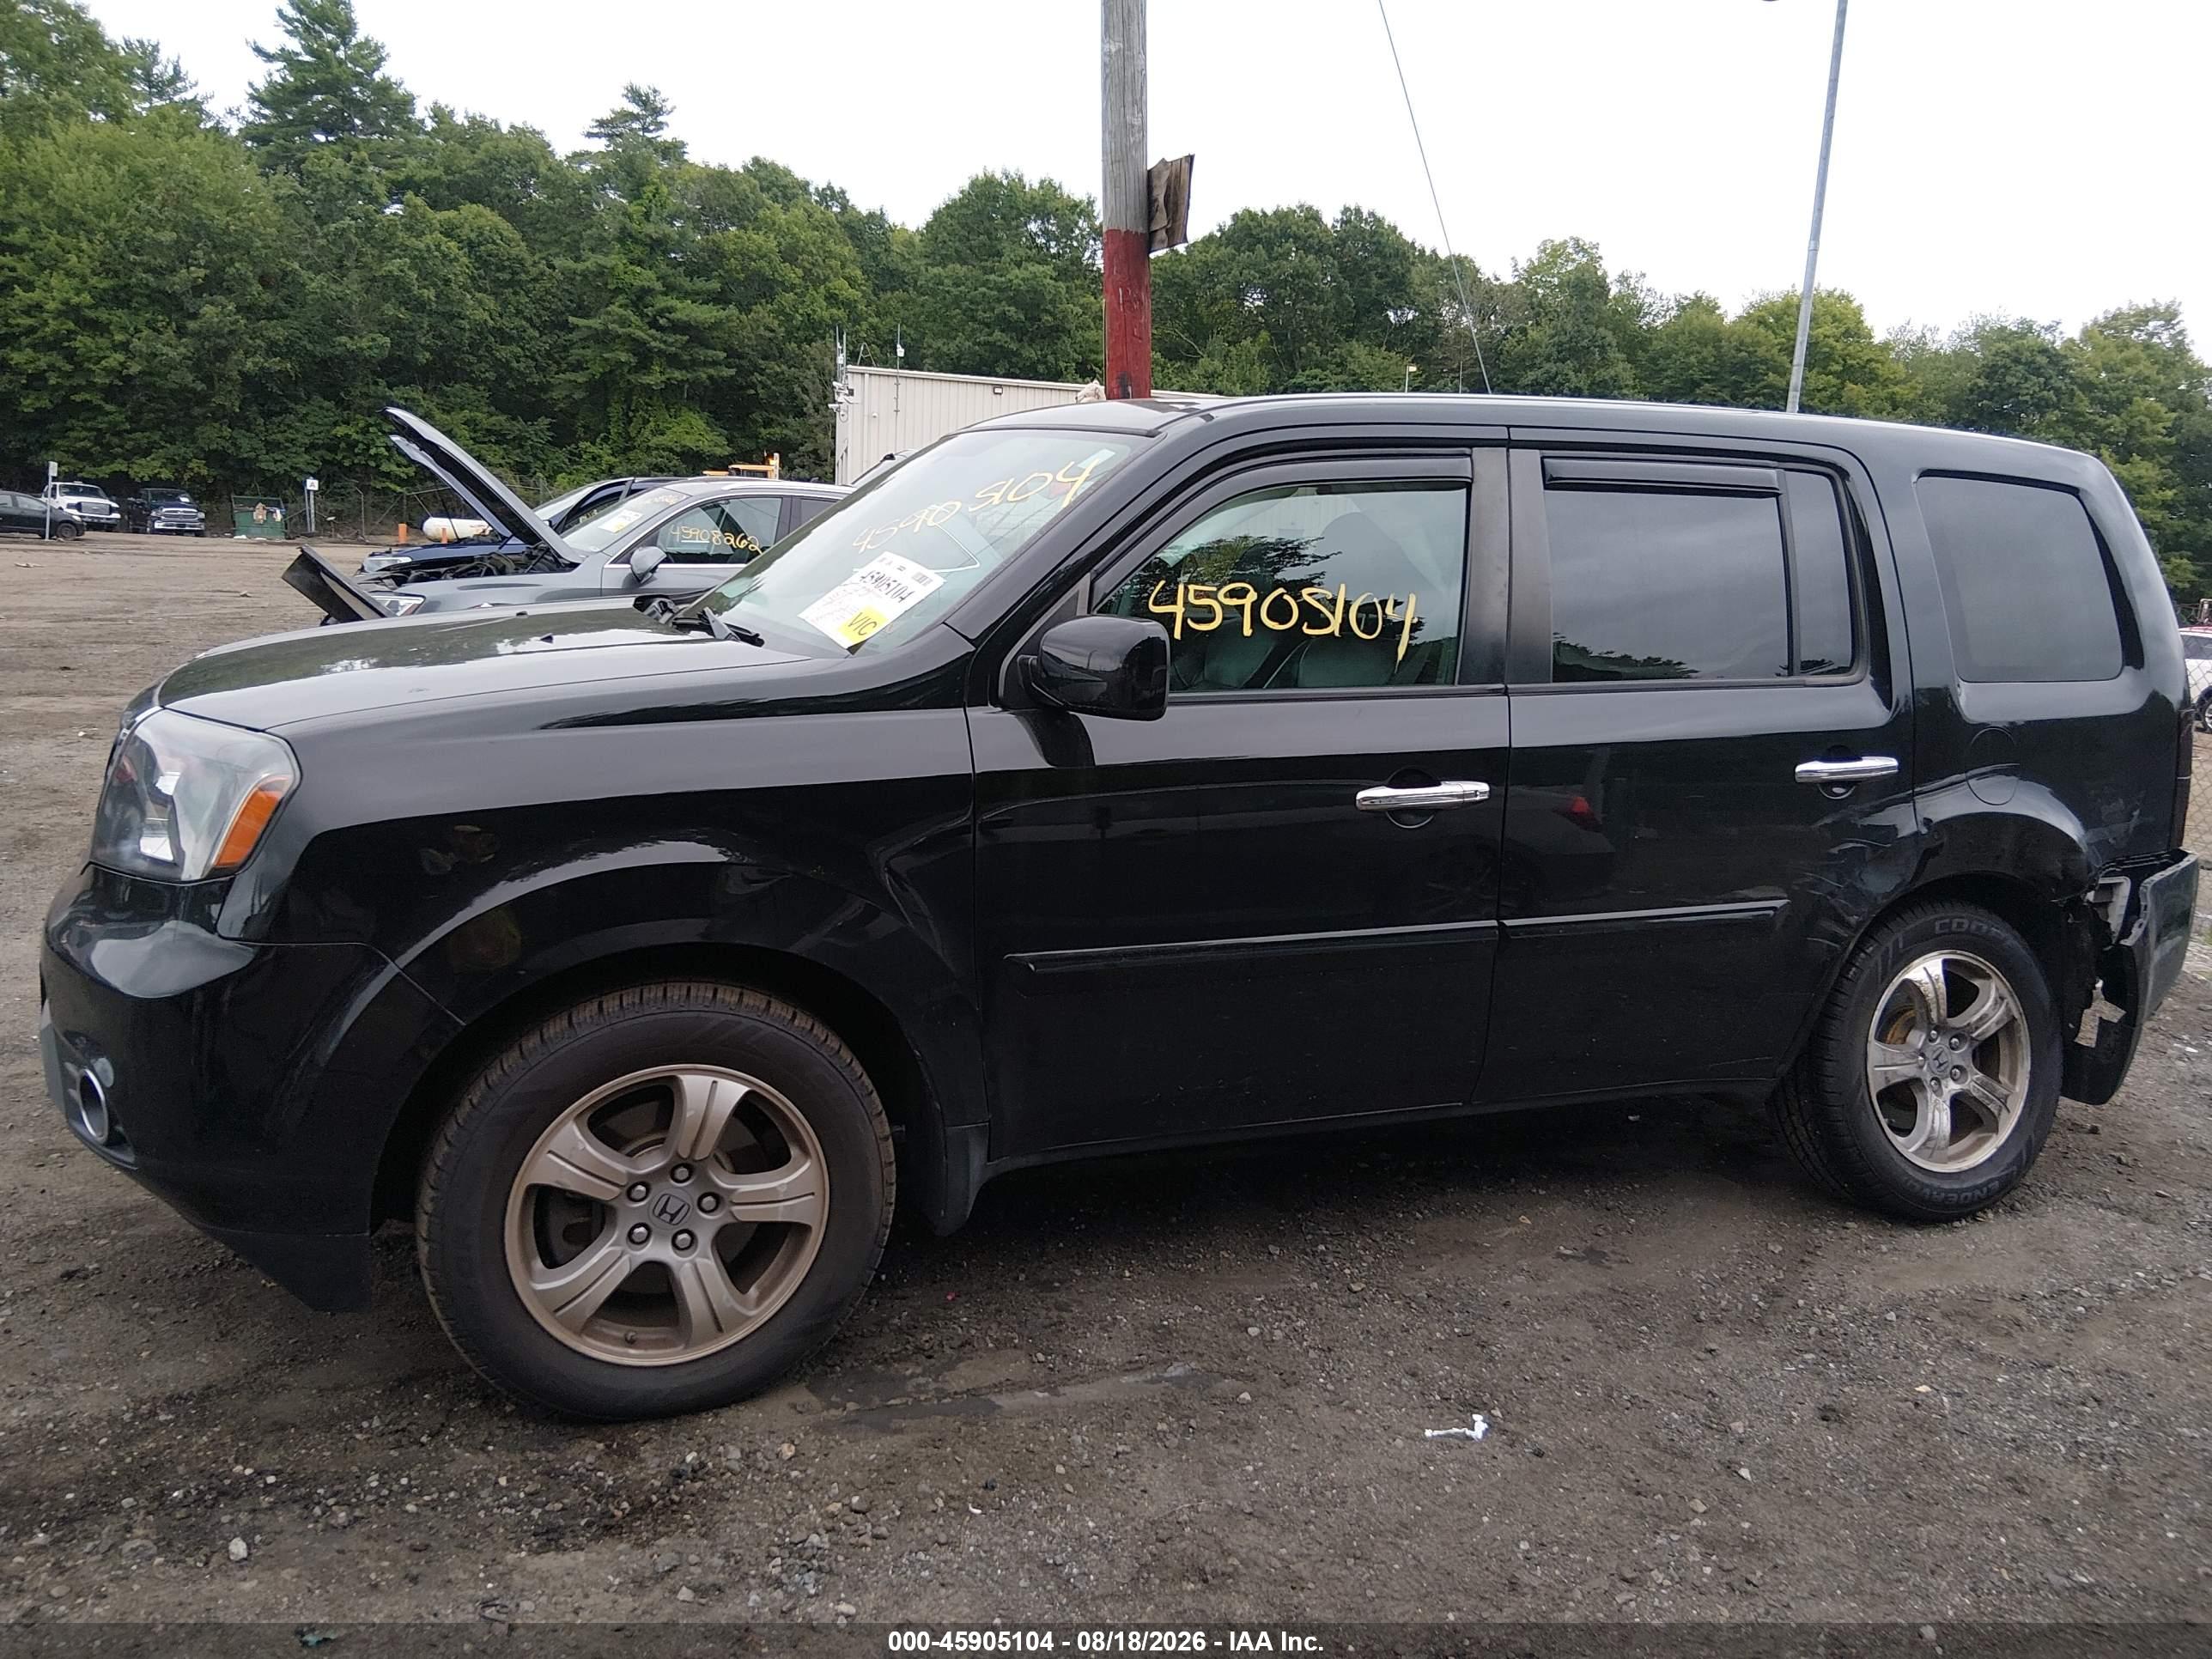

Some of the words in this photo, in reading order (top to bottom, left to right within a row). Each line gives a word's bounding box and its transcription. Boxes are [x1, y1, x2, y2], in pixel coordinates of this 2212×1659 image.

[669, 524, 763, 556] 45908262
[848, 611, 878, 636] VIC
[1148, 579, 1419, 674] 45905104
